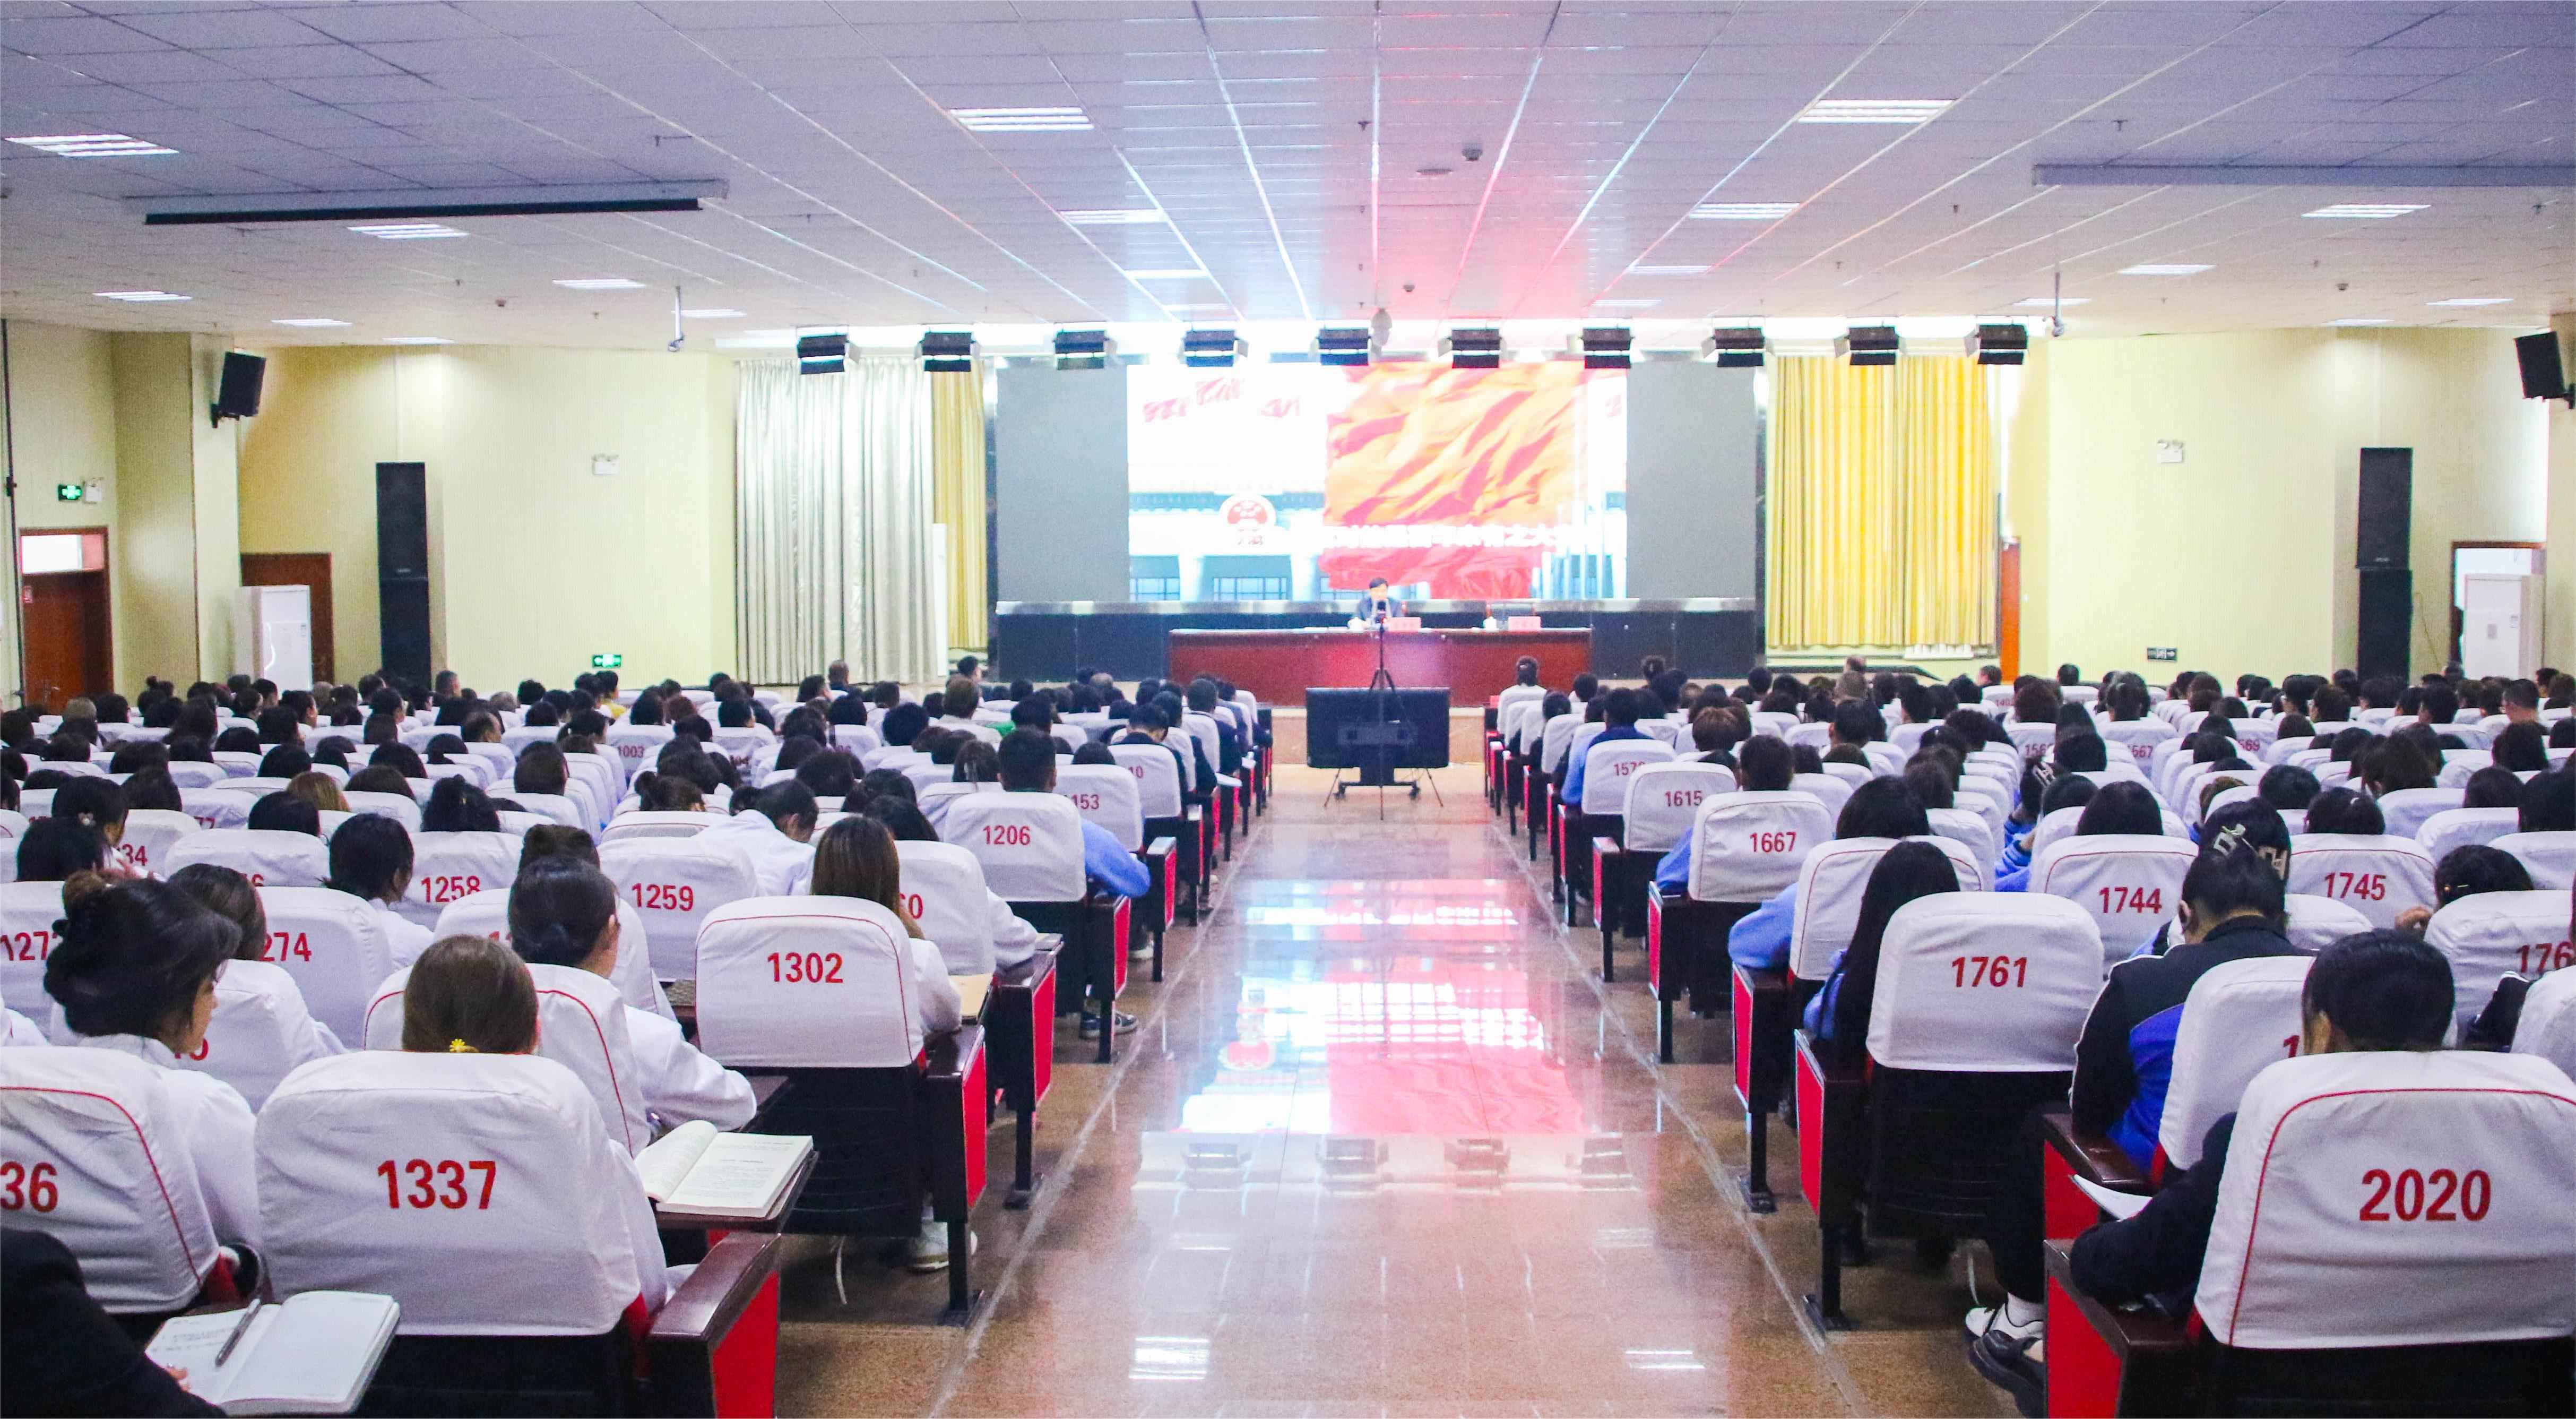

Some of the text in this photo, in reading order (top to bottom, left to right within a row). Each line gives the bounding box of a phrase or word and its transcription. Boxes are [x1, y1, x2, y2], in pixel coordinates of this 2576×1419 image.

[1614, 761, 1645, 776] 157
[1071, 794, 1100, 810] 153
[1665, 790, 1702, 807] 1615
[983, 825, 1031, 846] 1206
[1750, 831, 1797, 854] 1667
[123, 843, 148, 866] 34
[421, 875, 481, 904] 1258
[632, 883, 694, 911] 1259
[2099, 886, 2163, 914] 1744
[2324, 872, 2387, 901] 1745
[0, 931, 57, 961] 127
[260, 932, 312, 962] 274
[2516, 941, 2574, 973] 176
[767, 952, 843, 984] 1302
[1951, 955, 2028, 988] 1761
[0, 1161, 58, 1212] 36
[377, 1158, 497, 1210] 1337
[2359, 1168, 2492, 1222] 2020
